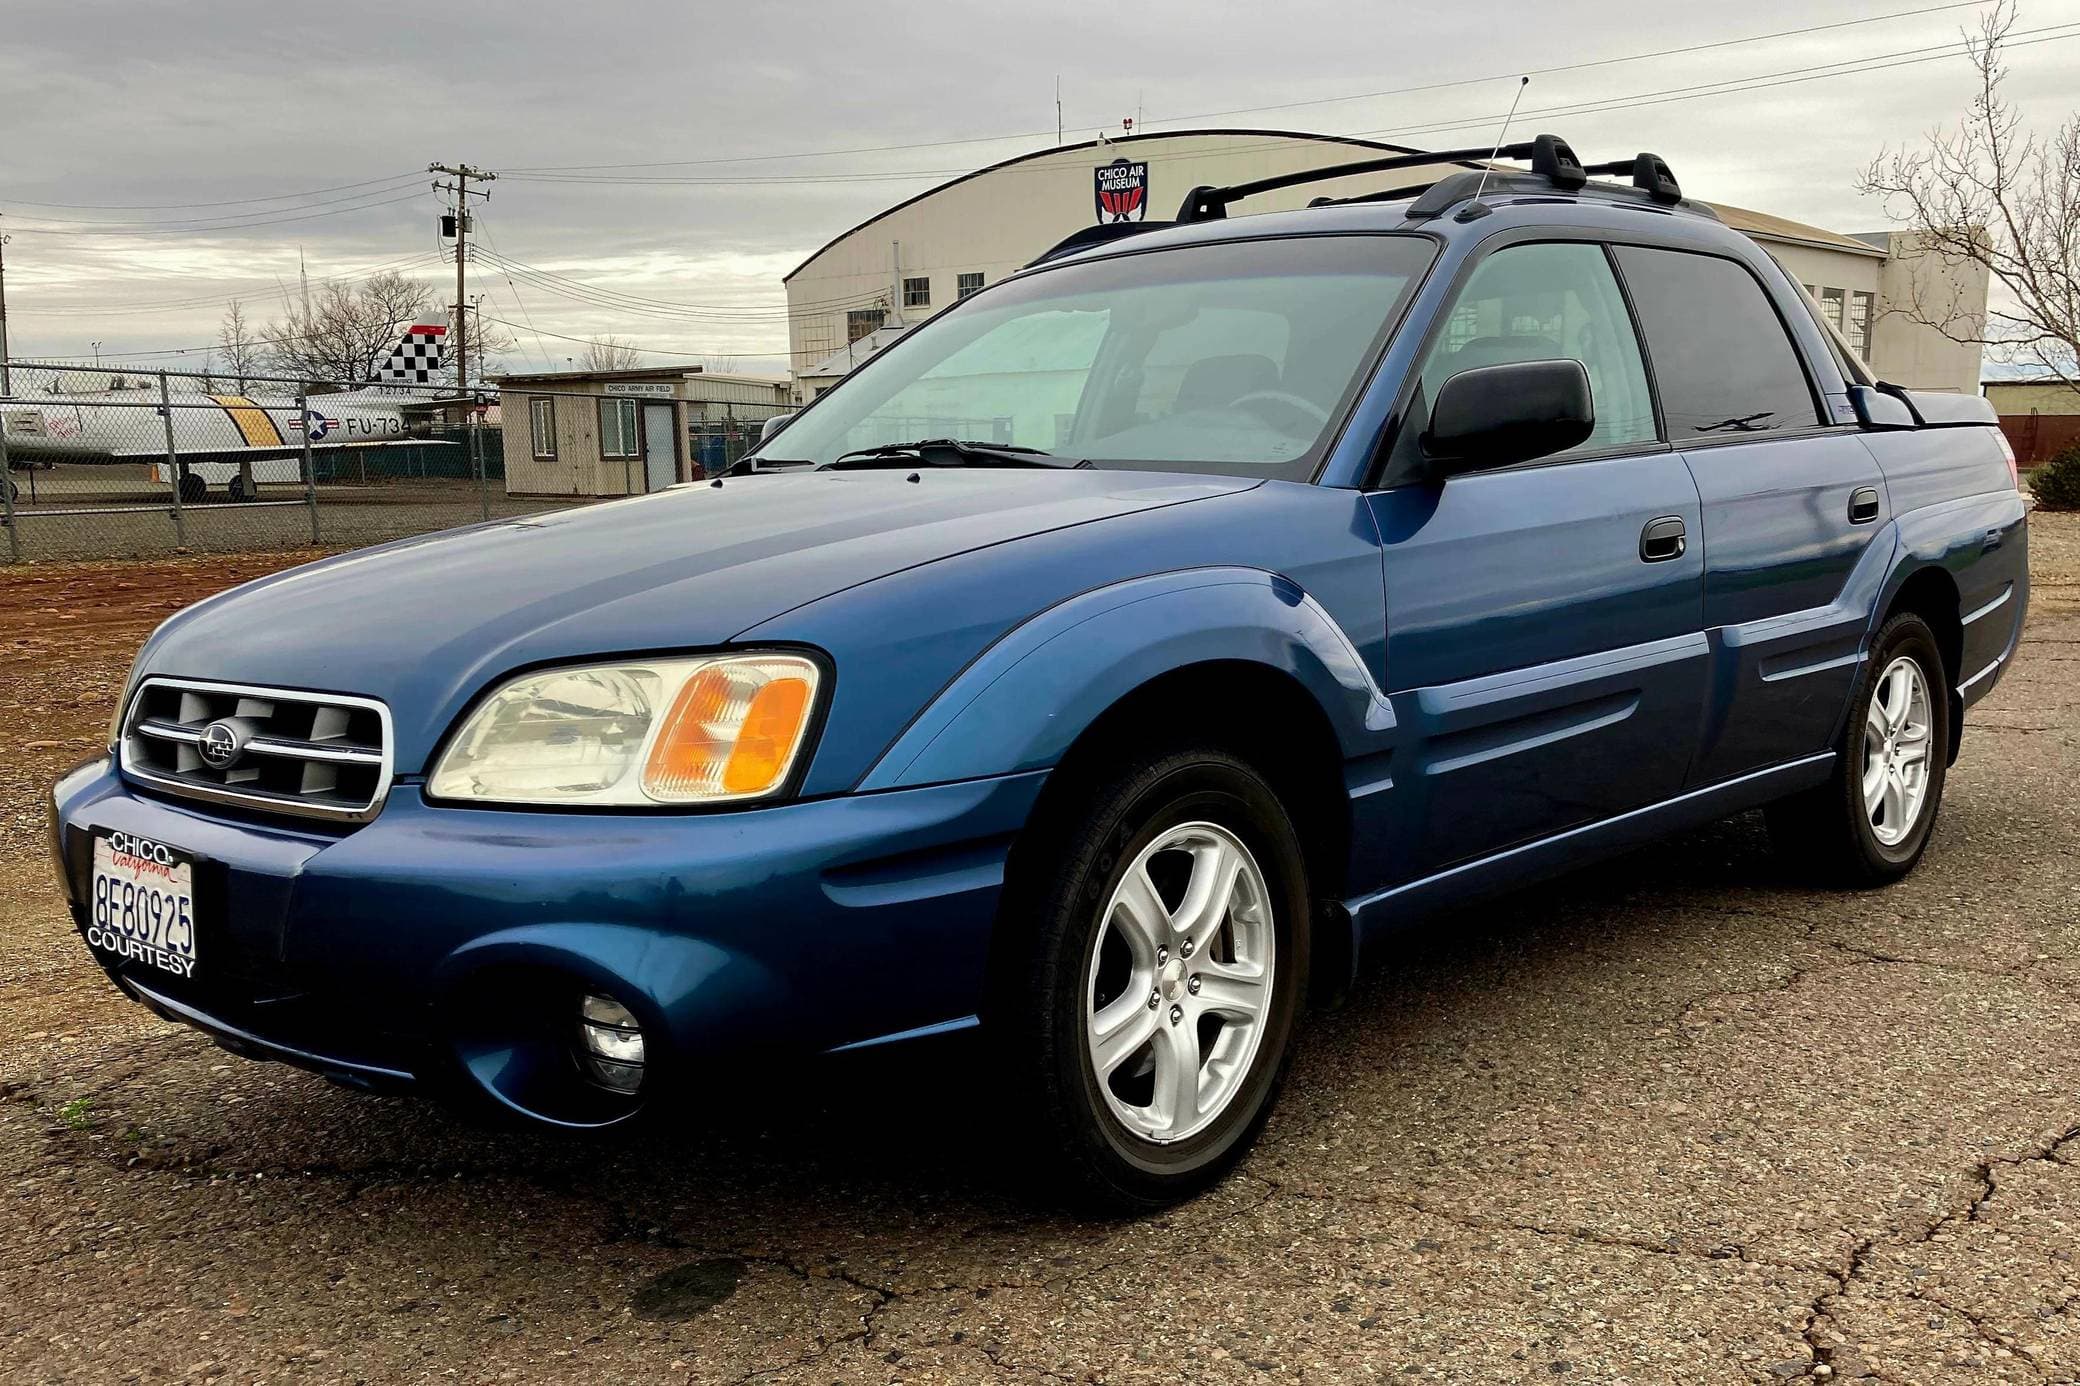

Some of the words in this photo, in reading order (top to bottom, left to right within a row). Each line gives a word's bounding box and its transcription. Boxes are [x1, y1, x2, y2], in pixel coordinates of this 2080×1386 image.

[1098, 167, 1127, 181] CHICO
[1129, 165, 1144, 177] AIR
[1101, 176, 1141, 191] MUSEUM
[608, 384, 626, 392] CHICO
[628, 384, 643, 392] ARMY
[656, 385, 671, 393] FIELD
[346, 417, 411, 435] FU-734
[112, 831, 169, 865] CHICO
[96, 873, 193, 955] 8E80925
[87, 926, 196, 979] COURTESY
